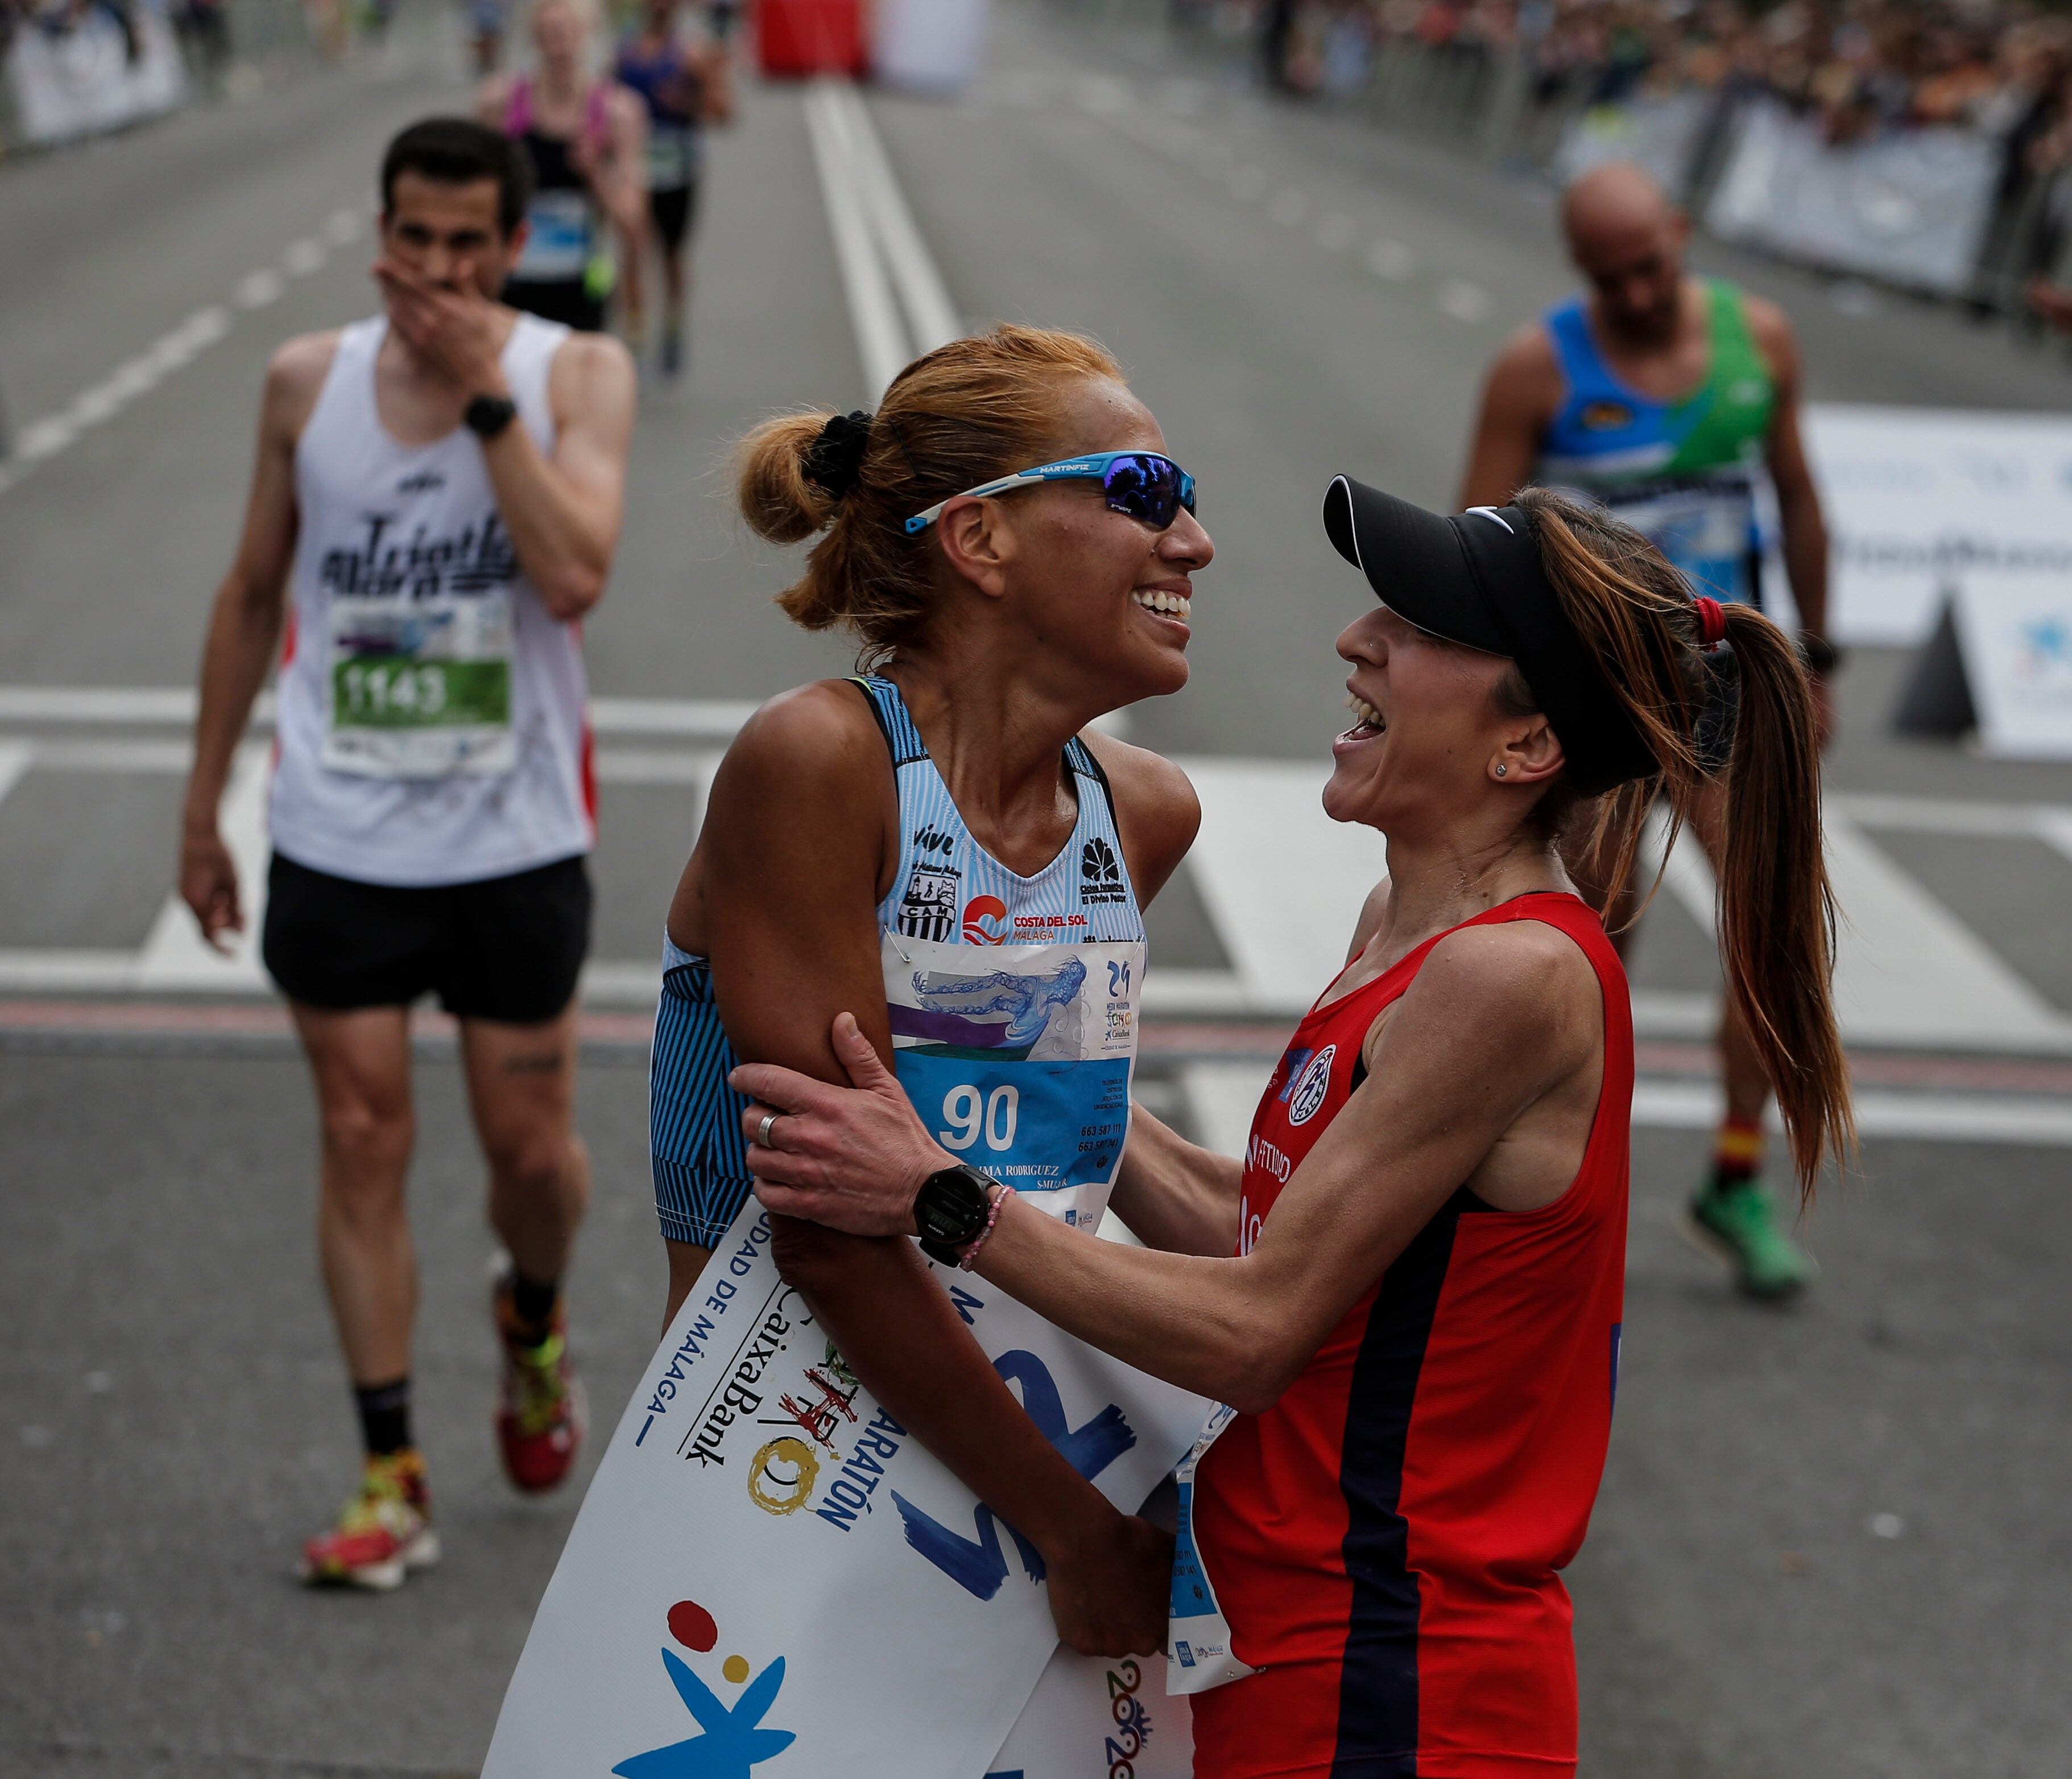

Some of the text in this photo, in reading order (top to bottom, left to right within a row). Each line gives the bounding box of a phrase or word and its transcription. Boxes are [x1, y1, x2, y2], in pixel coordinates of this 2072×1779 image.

[345, 665, 448, 714] 1143
[1082, 894, 1126, 905] El Divino Pastor
[907, 906, 948, 917] CAM
[1014, 915, 1088, 927] COSTA DEL SOL
[1014, 928, 1054, 940] MÁLAGA
[939, 1084, 1019, 1151] 90
[1081, 1123, 1121, 1137] 663 587 111
[1078, 1141, 1094, 1152] 663
[1006, 1165, 1060, 1176] RODRIGUEZ
[928, 1224, 945, 1235] GARMIN
[647, 1211, 772, 1415] UDAD DE MÁLAGA
[685, 1287, 814, 1469] CaixaBank
[815, 1406, 908, 1533] ARATÓN
